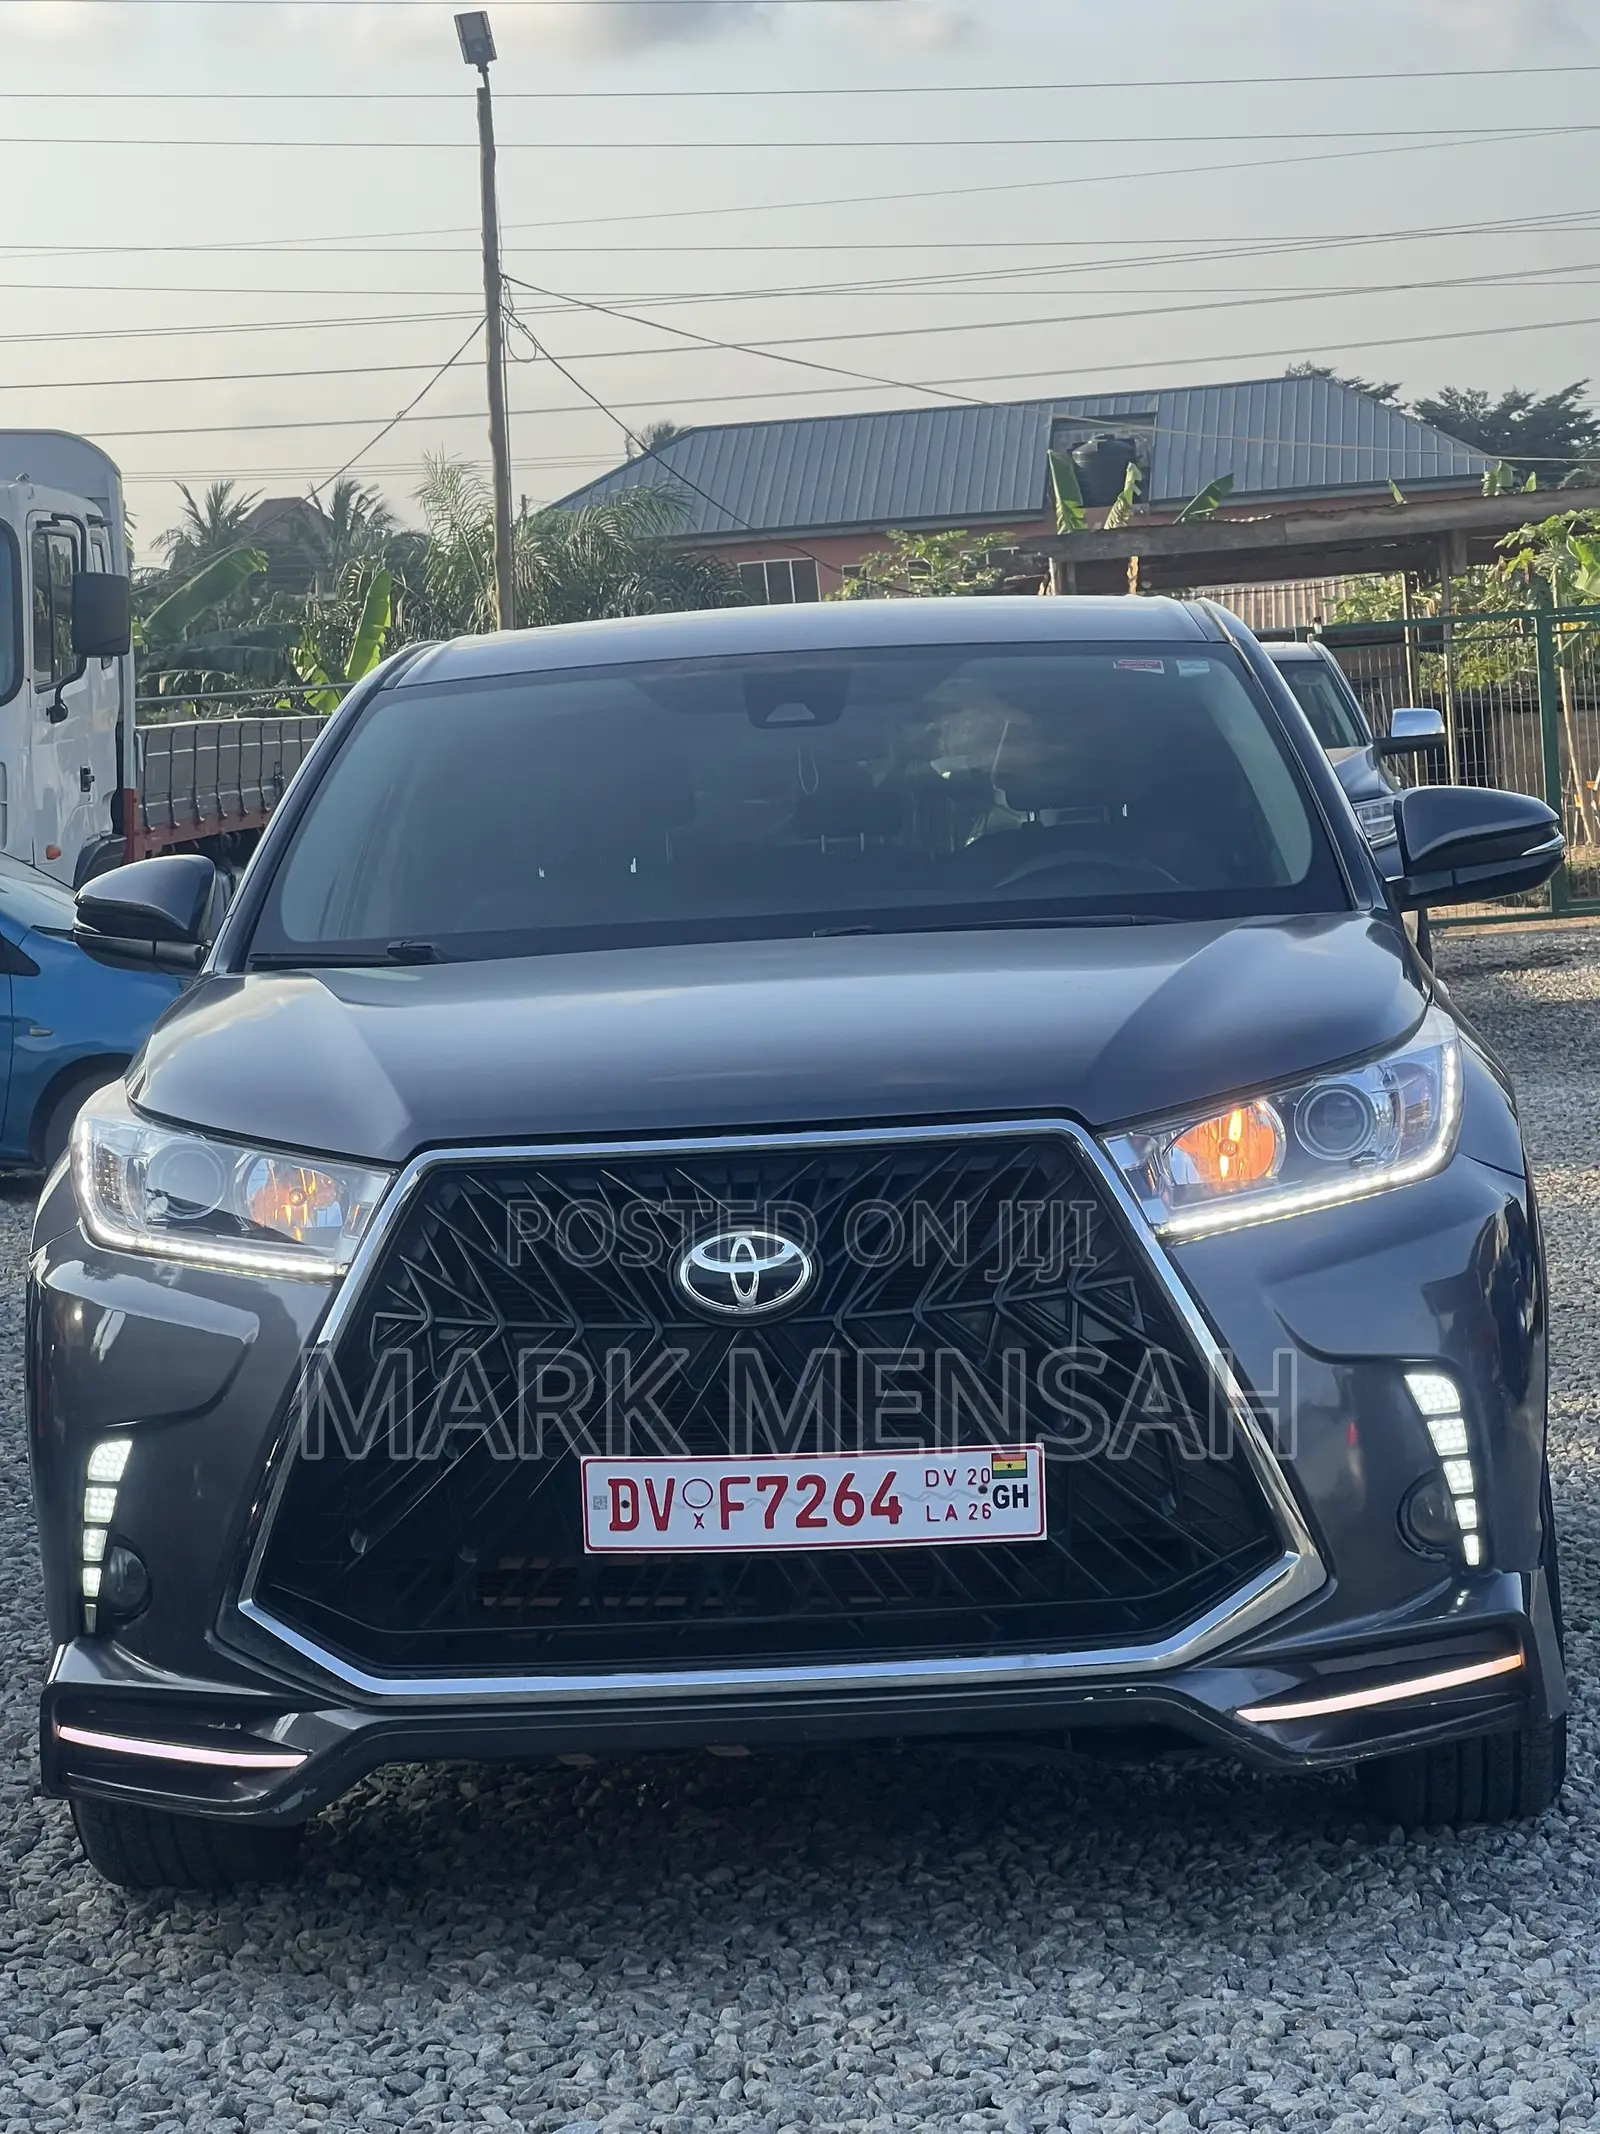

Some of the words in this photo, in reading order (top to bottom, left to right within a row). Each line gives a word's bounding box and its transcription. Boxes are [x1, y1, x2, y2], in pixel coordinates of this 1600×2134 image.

[925, 1469, 957, 1487] DV
[967, 1467, 991, 1486] 20
[607, 1478, 676, 1532] DV
[719, 1470, 903, 1530] F7264
[992, 1484, 1029, 1509] GH
[926, 1504, 958, 1522] LA
[968, 1503, 992, 1520] 26
